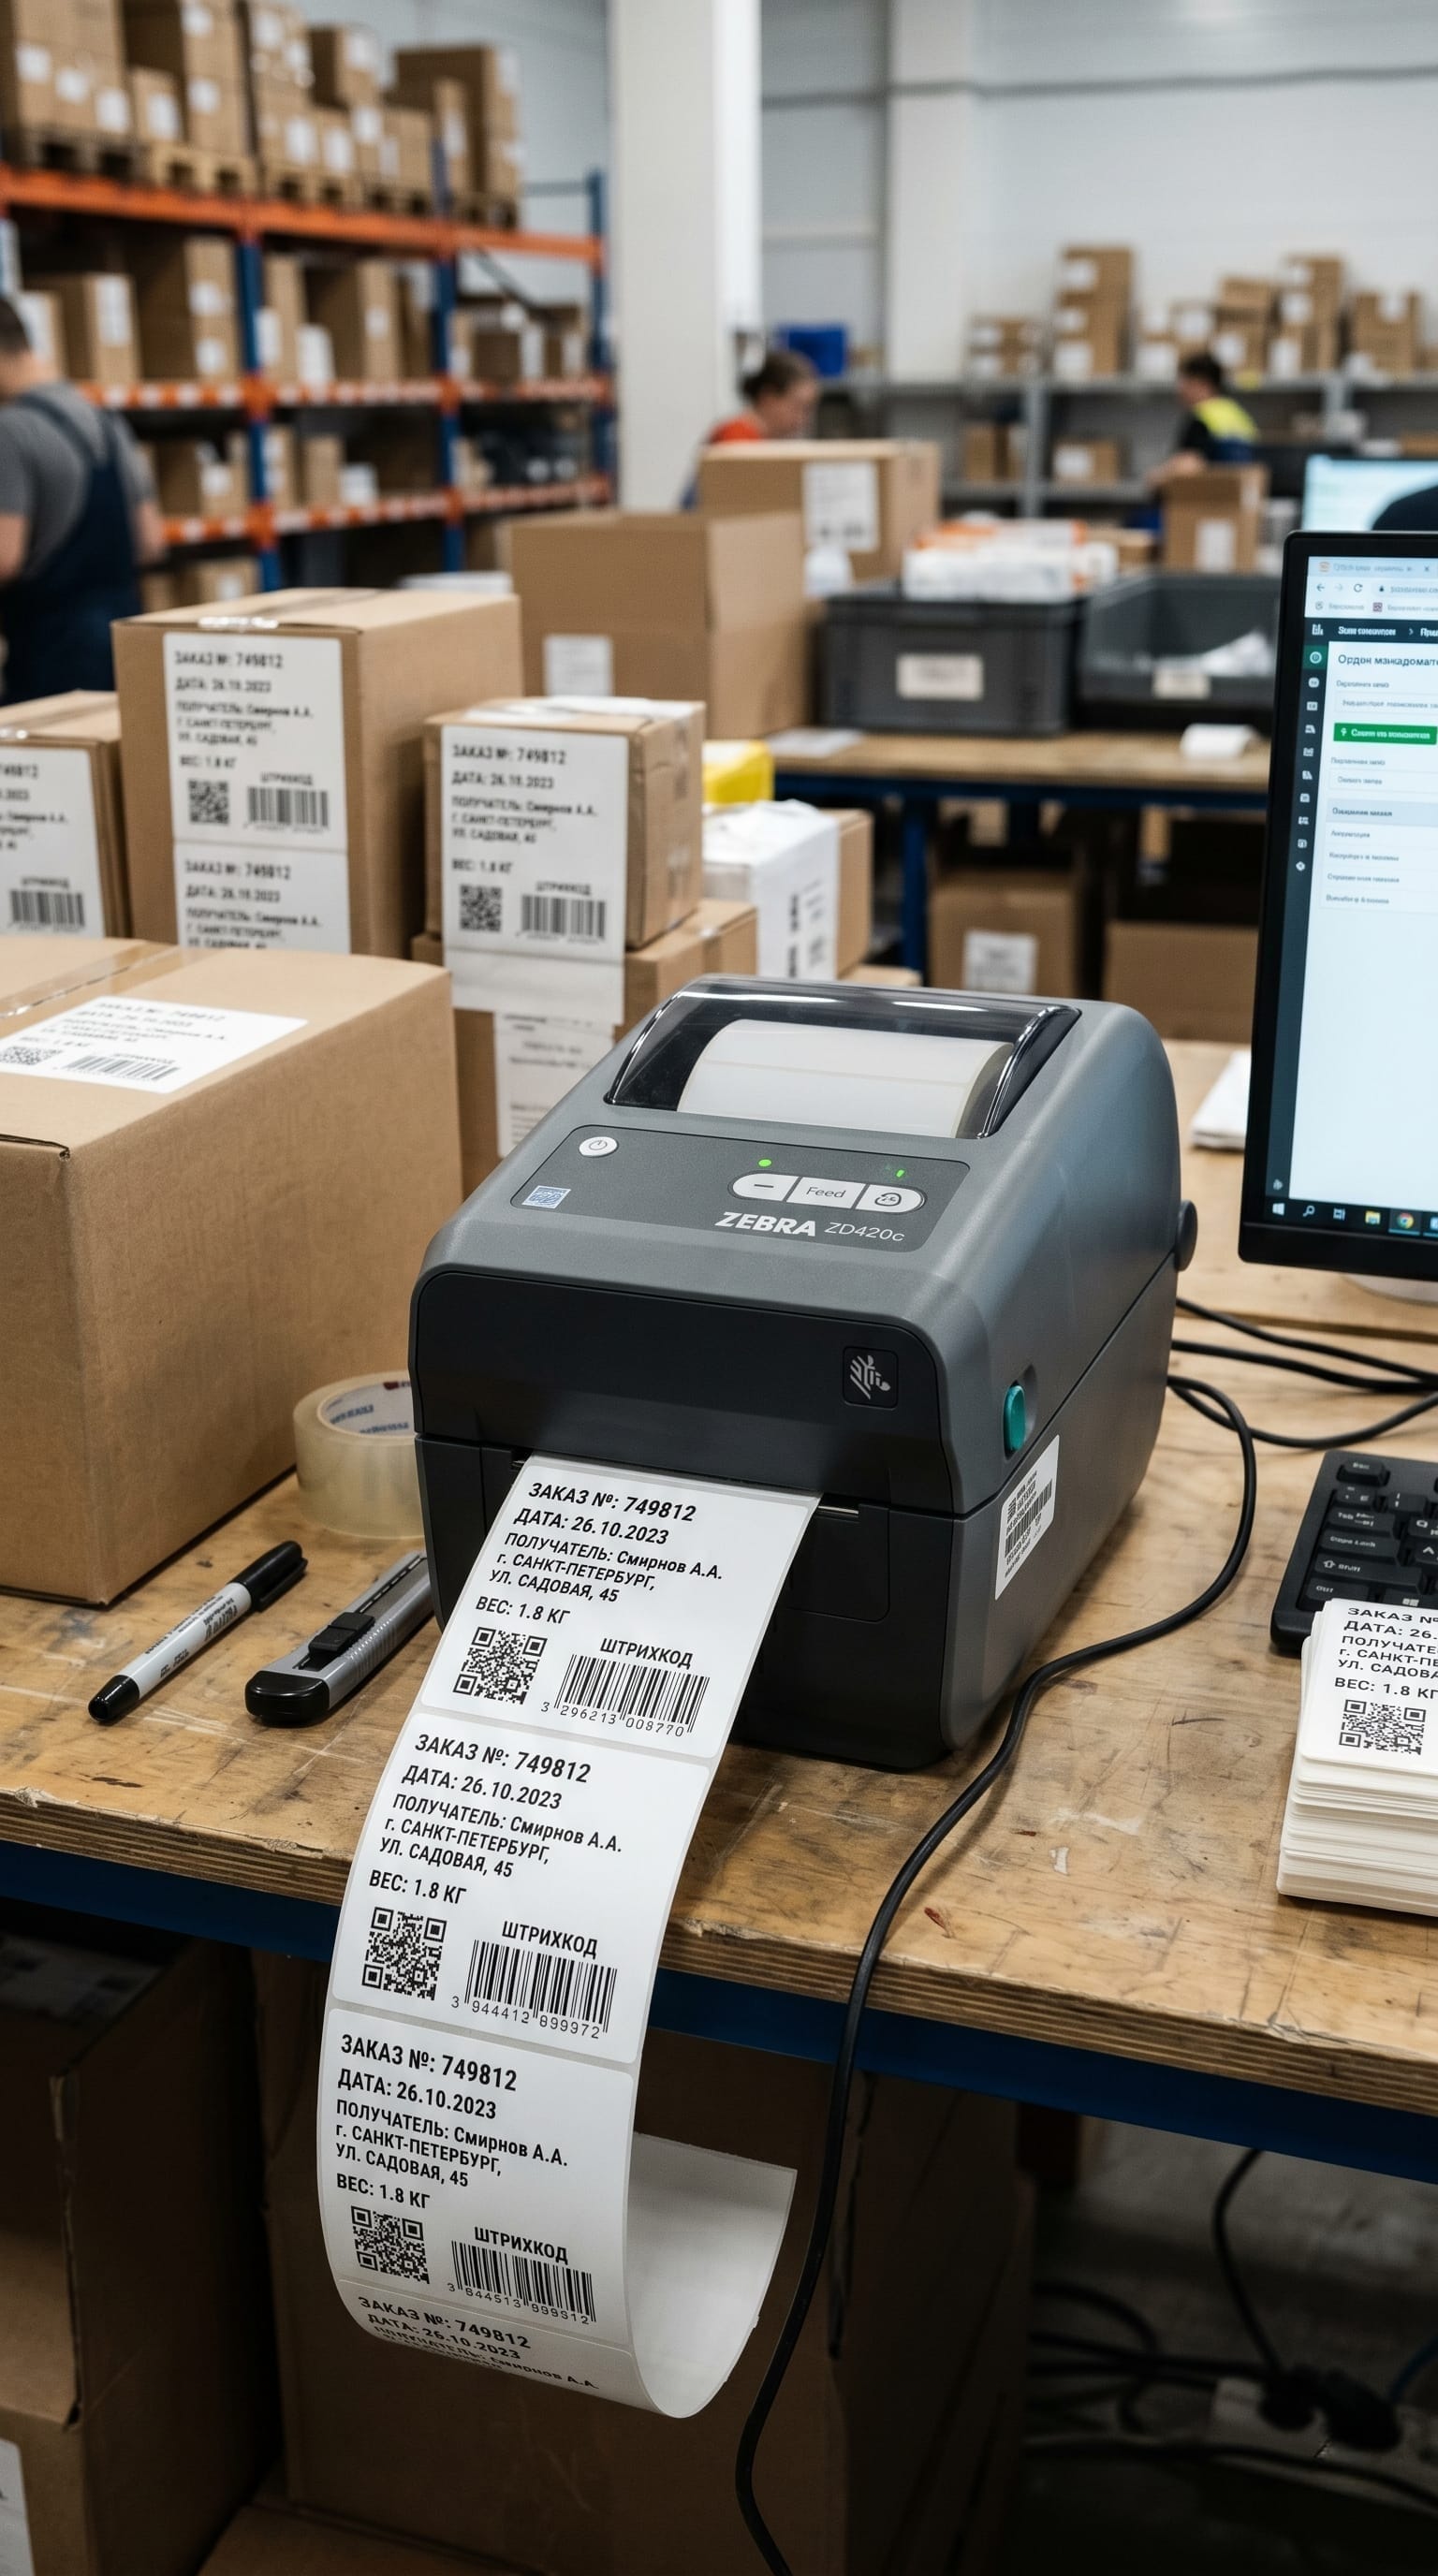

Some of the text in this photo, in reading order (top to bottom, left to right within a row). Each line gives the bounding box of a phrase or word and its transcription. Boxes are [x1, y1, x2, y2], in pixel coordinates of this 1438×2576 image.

[806, 1185, 846, 1200] Feed
[714, 1211, 905, 1242] ZEBRA ZD420c
[528, 1482, 697, 1522] ЗАКАЗ №: 749812
[513, 1508, 668, 1545] ДАТА: 26.10.2023
[496, 1553, 656, 1590] г. САНКТ-ПЕТЕРБУРГ,
[504, 1532, 723, 1580] ПОЛУЧАТЕЛЬ: Смирнов А.А.
[489, 1569, 620, 1603] УЛ. САДОВАЯ, 45
[476, 1596, 571, 1625] ВЕС: 1.8 КГ
[1343, 1620, 1402, 1635] ДАТА:
[1348, 1608, 1413, 1621] ЗАКАЗ
[599, 1637, 694, 1670] ШТРИХКОД
[1342, 1635, 1438, 1654] ПОЛУЧАТЕ
[1338, 1660, 1363, 1670] УЛ.
[1335, 1677, 1375, 1691] ВЕС:
[1383, 1684, 1410, 1696] 1.8
[541, 1702, 684, 1736] 3 296213 008770
[415, 1734, 592, 1783] ЗАКАЗ №: 749812
[402, 1764, 562, 1810] ДАТА: 26.10.2023
[392, 1793, 622, 1852] ПОЛУЧАТЕЛЬ: Смирнов А.А.
[379, 1837, 514, 1878] УЛ. САДОВАЯ, 45
[384, 1818, 550, 1865] г. САНКТ-ПЕТЕРБУРГ,
[369, 1869, 466, 1905] ВЕС: 1.8 КГ
[501, 1921, 598, 1959] ШТРИХКОД
[451, 1996, 460, 2008] 3
[539, 2015, 600, 2039] 899972
[341, 2034, 518, 2092] ЗАКАЗ №: 749812
[337, 2068, 497, 2120] ДАТА: 26.10.2023
[335, 2123, 502, 2177] г. САНКТ-ПЕТЕРБУРГ,
[336, 2099, 568, 2167] ПОЛУЧАТЕЛЬ: Смирнов А.А.
[335, 2143, 469, 2188] УЛ. САДОВАЯ, 45
[336, 2174, 431, 2210] ВЕС: 1.8 КГ
[474, 2226, 569, 2265] ШТРИХКОД
[448, 2282, 455, 2292] 3
[358, 2296, 419, 2320] ЗАКАЗ
[454, 2320, 531, 2349] 749812
[422, 2328, 521, 2359] 26.10.2023
